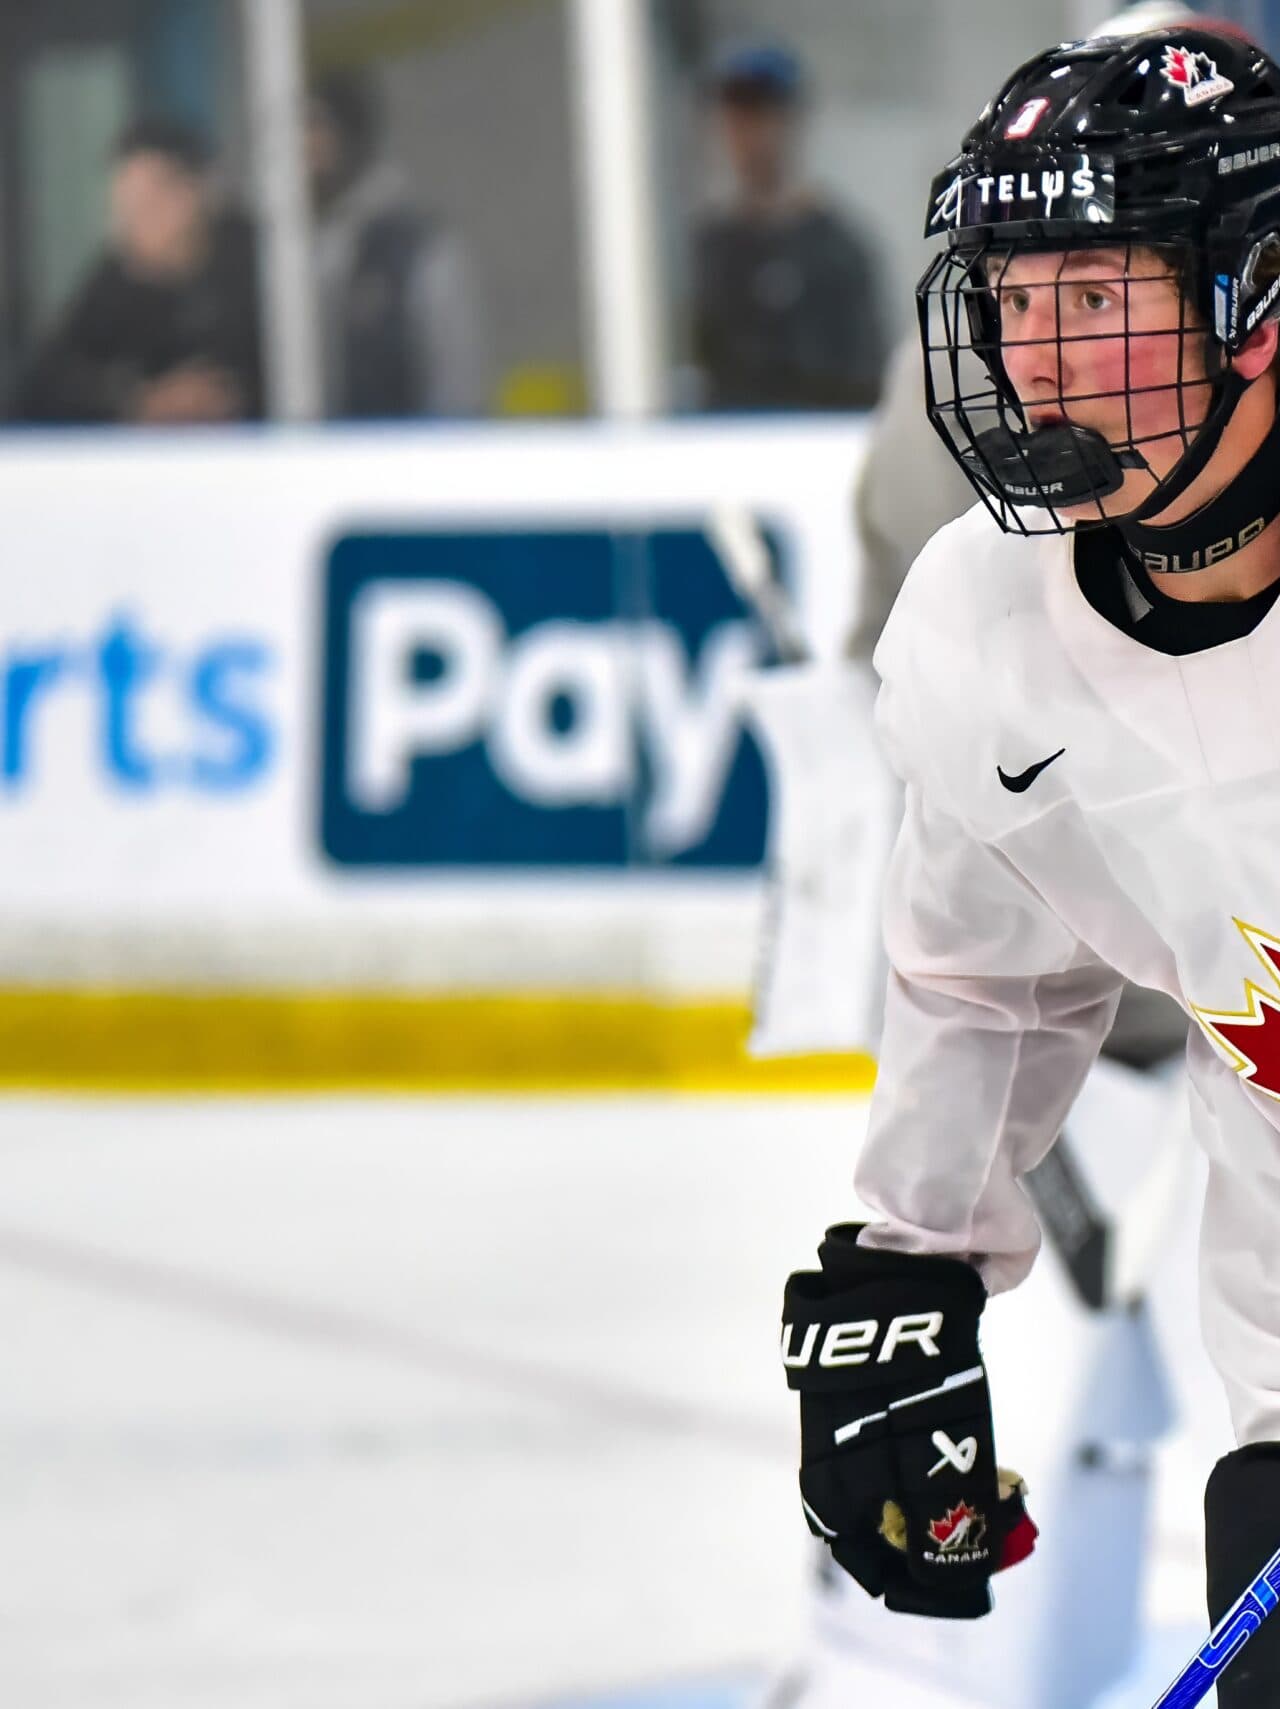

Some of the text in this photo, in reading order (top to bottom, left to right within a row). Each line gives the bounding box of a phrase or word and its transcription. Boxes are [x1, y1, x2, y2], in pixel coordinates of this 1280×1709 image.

[977, 169, 1095, 206] TELUS
[1218, 142, 1280, 175] BAUER
[1129, 516, 1266, 574] AUER
[0, 604, 275, 794] rts
[346, 578, 752, 860] Pay
